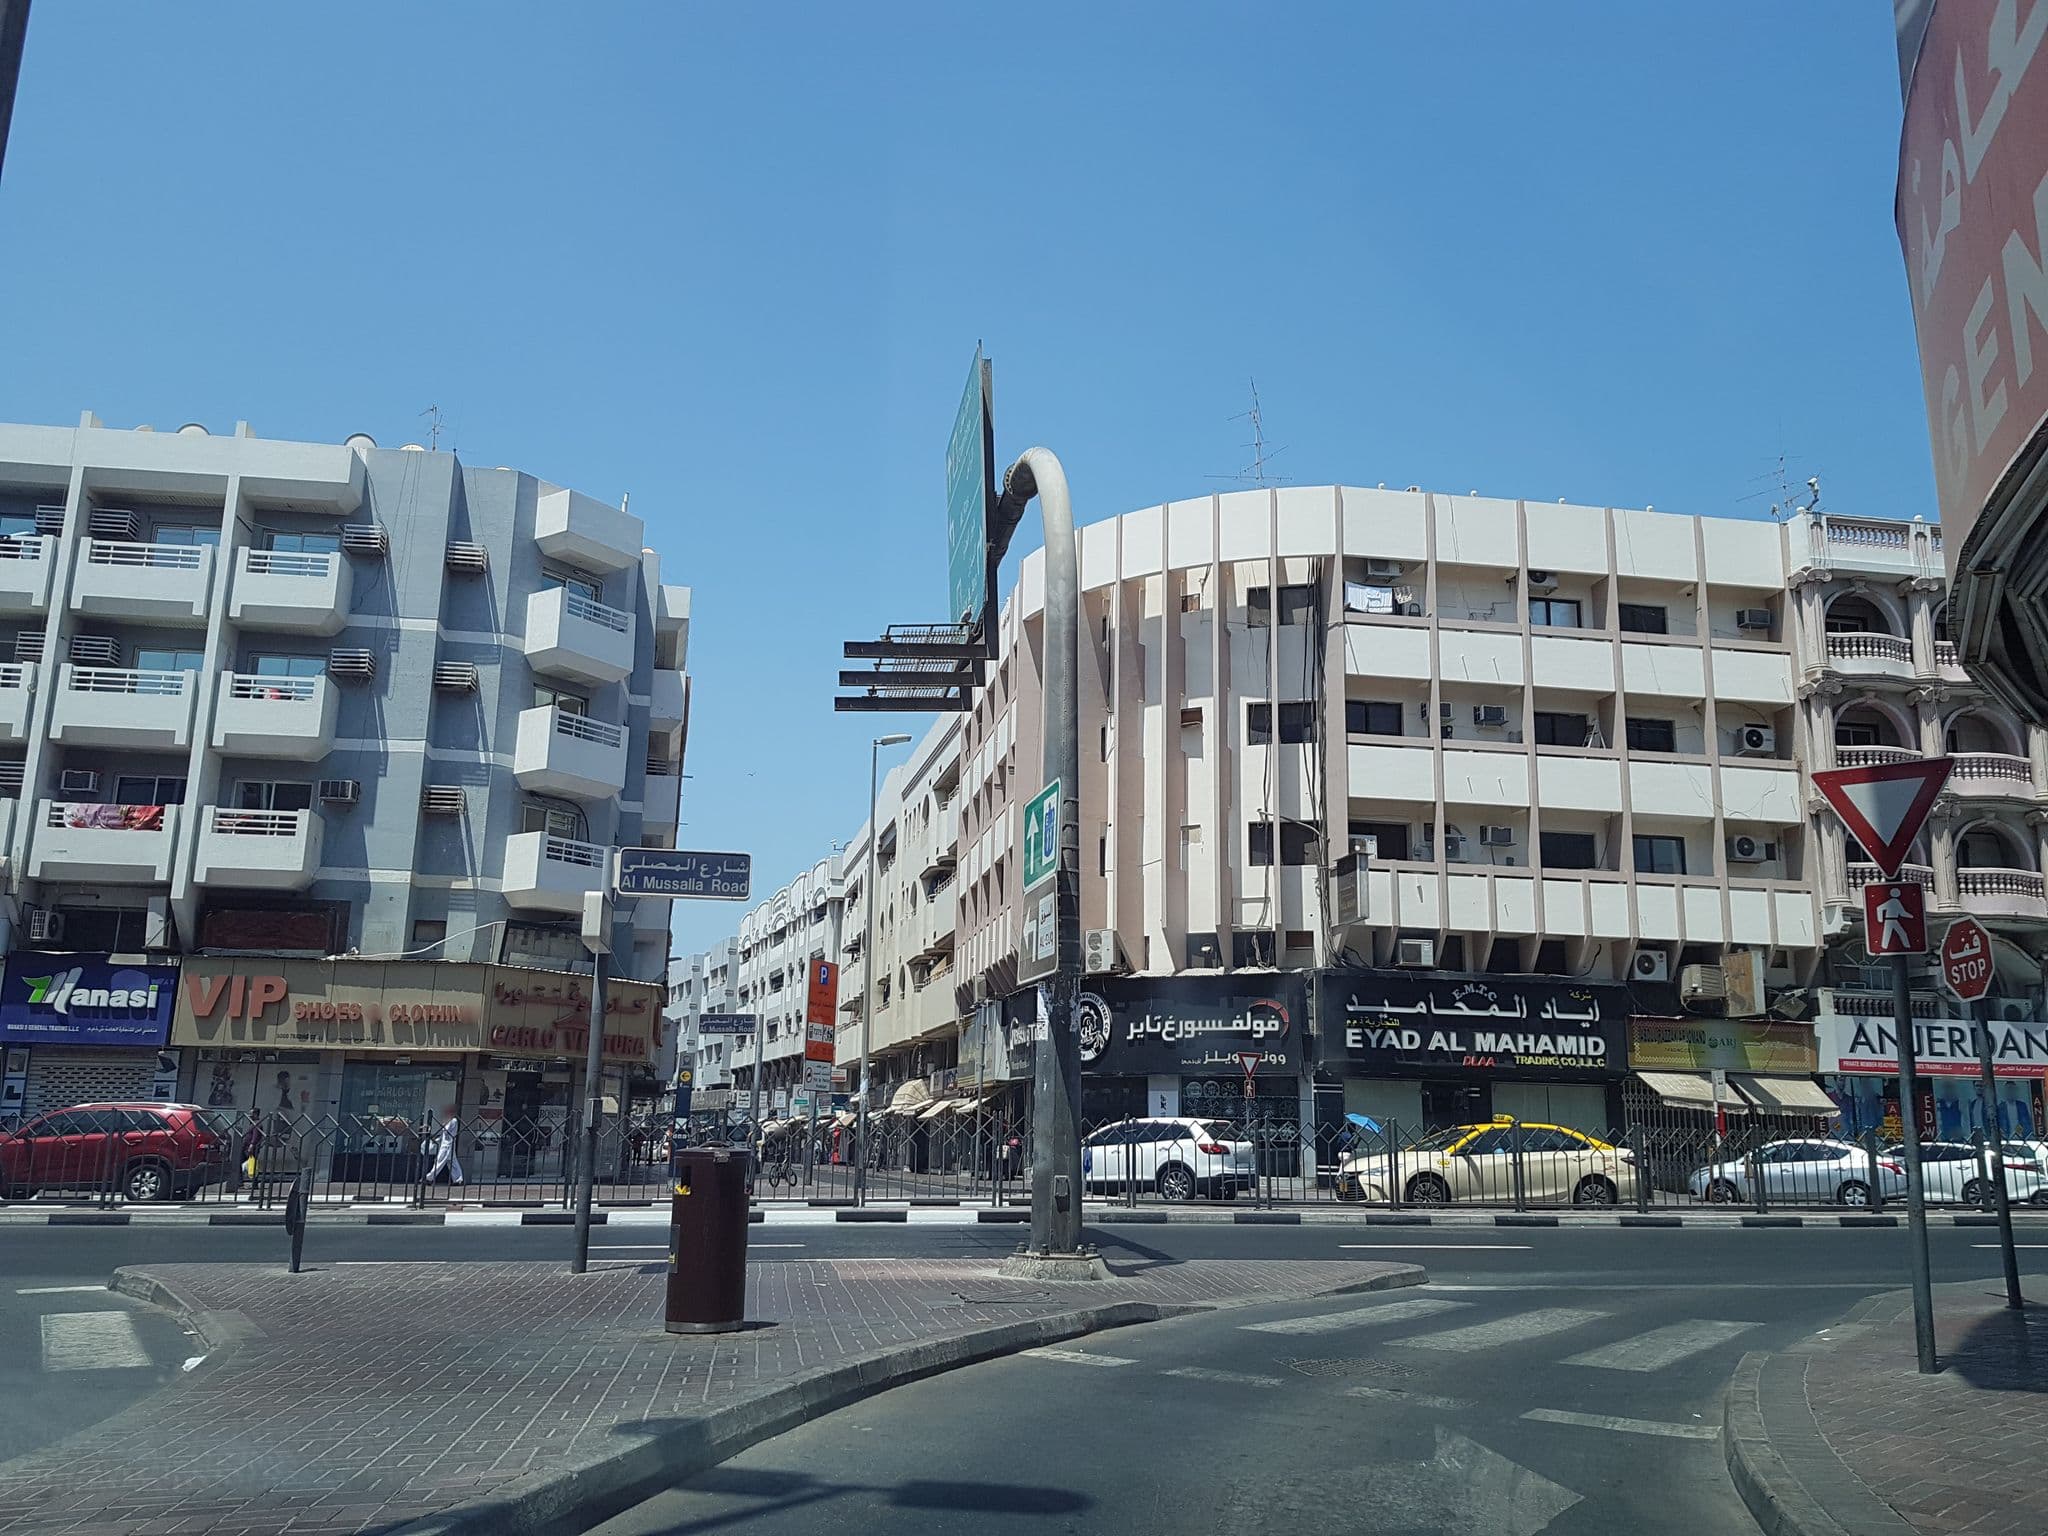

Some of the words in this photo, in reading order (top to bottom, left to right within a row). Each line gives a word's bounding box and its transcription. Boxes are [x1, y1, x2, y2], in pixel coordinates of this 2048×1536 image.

[622, 855, 697, 873] المصلى
[700, 859, 749, 878] شارع
[621, 874, 636, 888] Al
[643, 876, 704, 891] Mussalla
[711, 878, 748, 893] Road
[1950, 929, 1981, 960] قف
[820, 966, 829, 984] P
[1951, 958, 1986, 985] STOP
[185, 975, 288, 1018] VIP
[294, 1001, 362, 1020] SHOES
[389, 1003, 477, 1023] CLOTHIN
[1451, 983, 1498, 1002] E.M.T.C
[1568, 988, 1592, 1001] شركة
[1346, 991, 1528, 1020] المحاميد
[1345, 1028, 1421, 1050] EYAD
[1428, 1031, 1467, 1051] AL
[1474, 1032, 1606, 1056] MAHAMID
[1462, 1055, 1496, 1067] DLAA
[1514, 1055, 1560, 1066] TRADING
